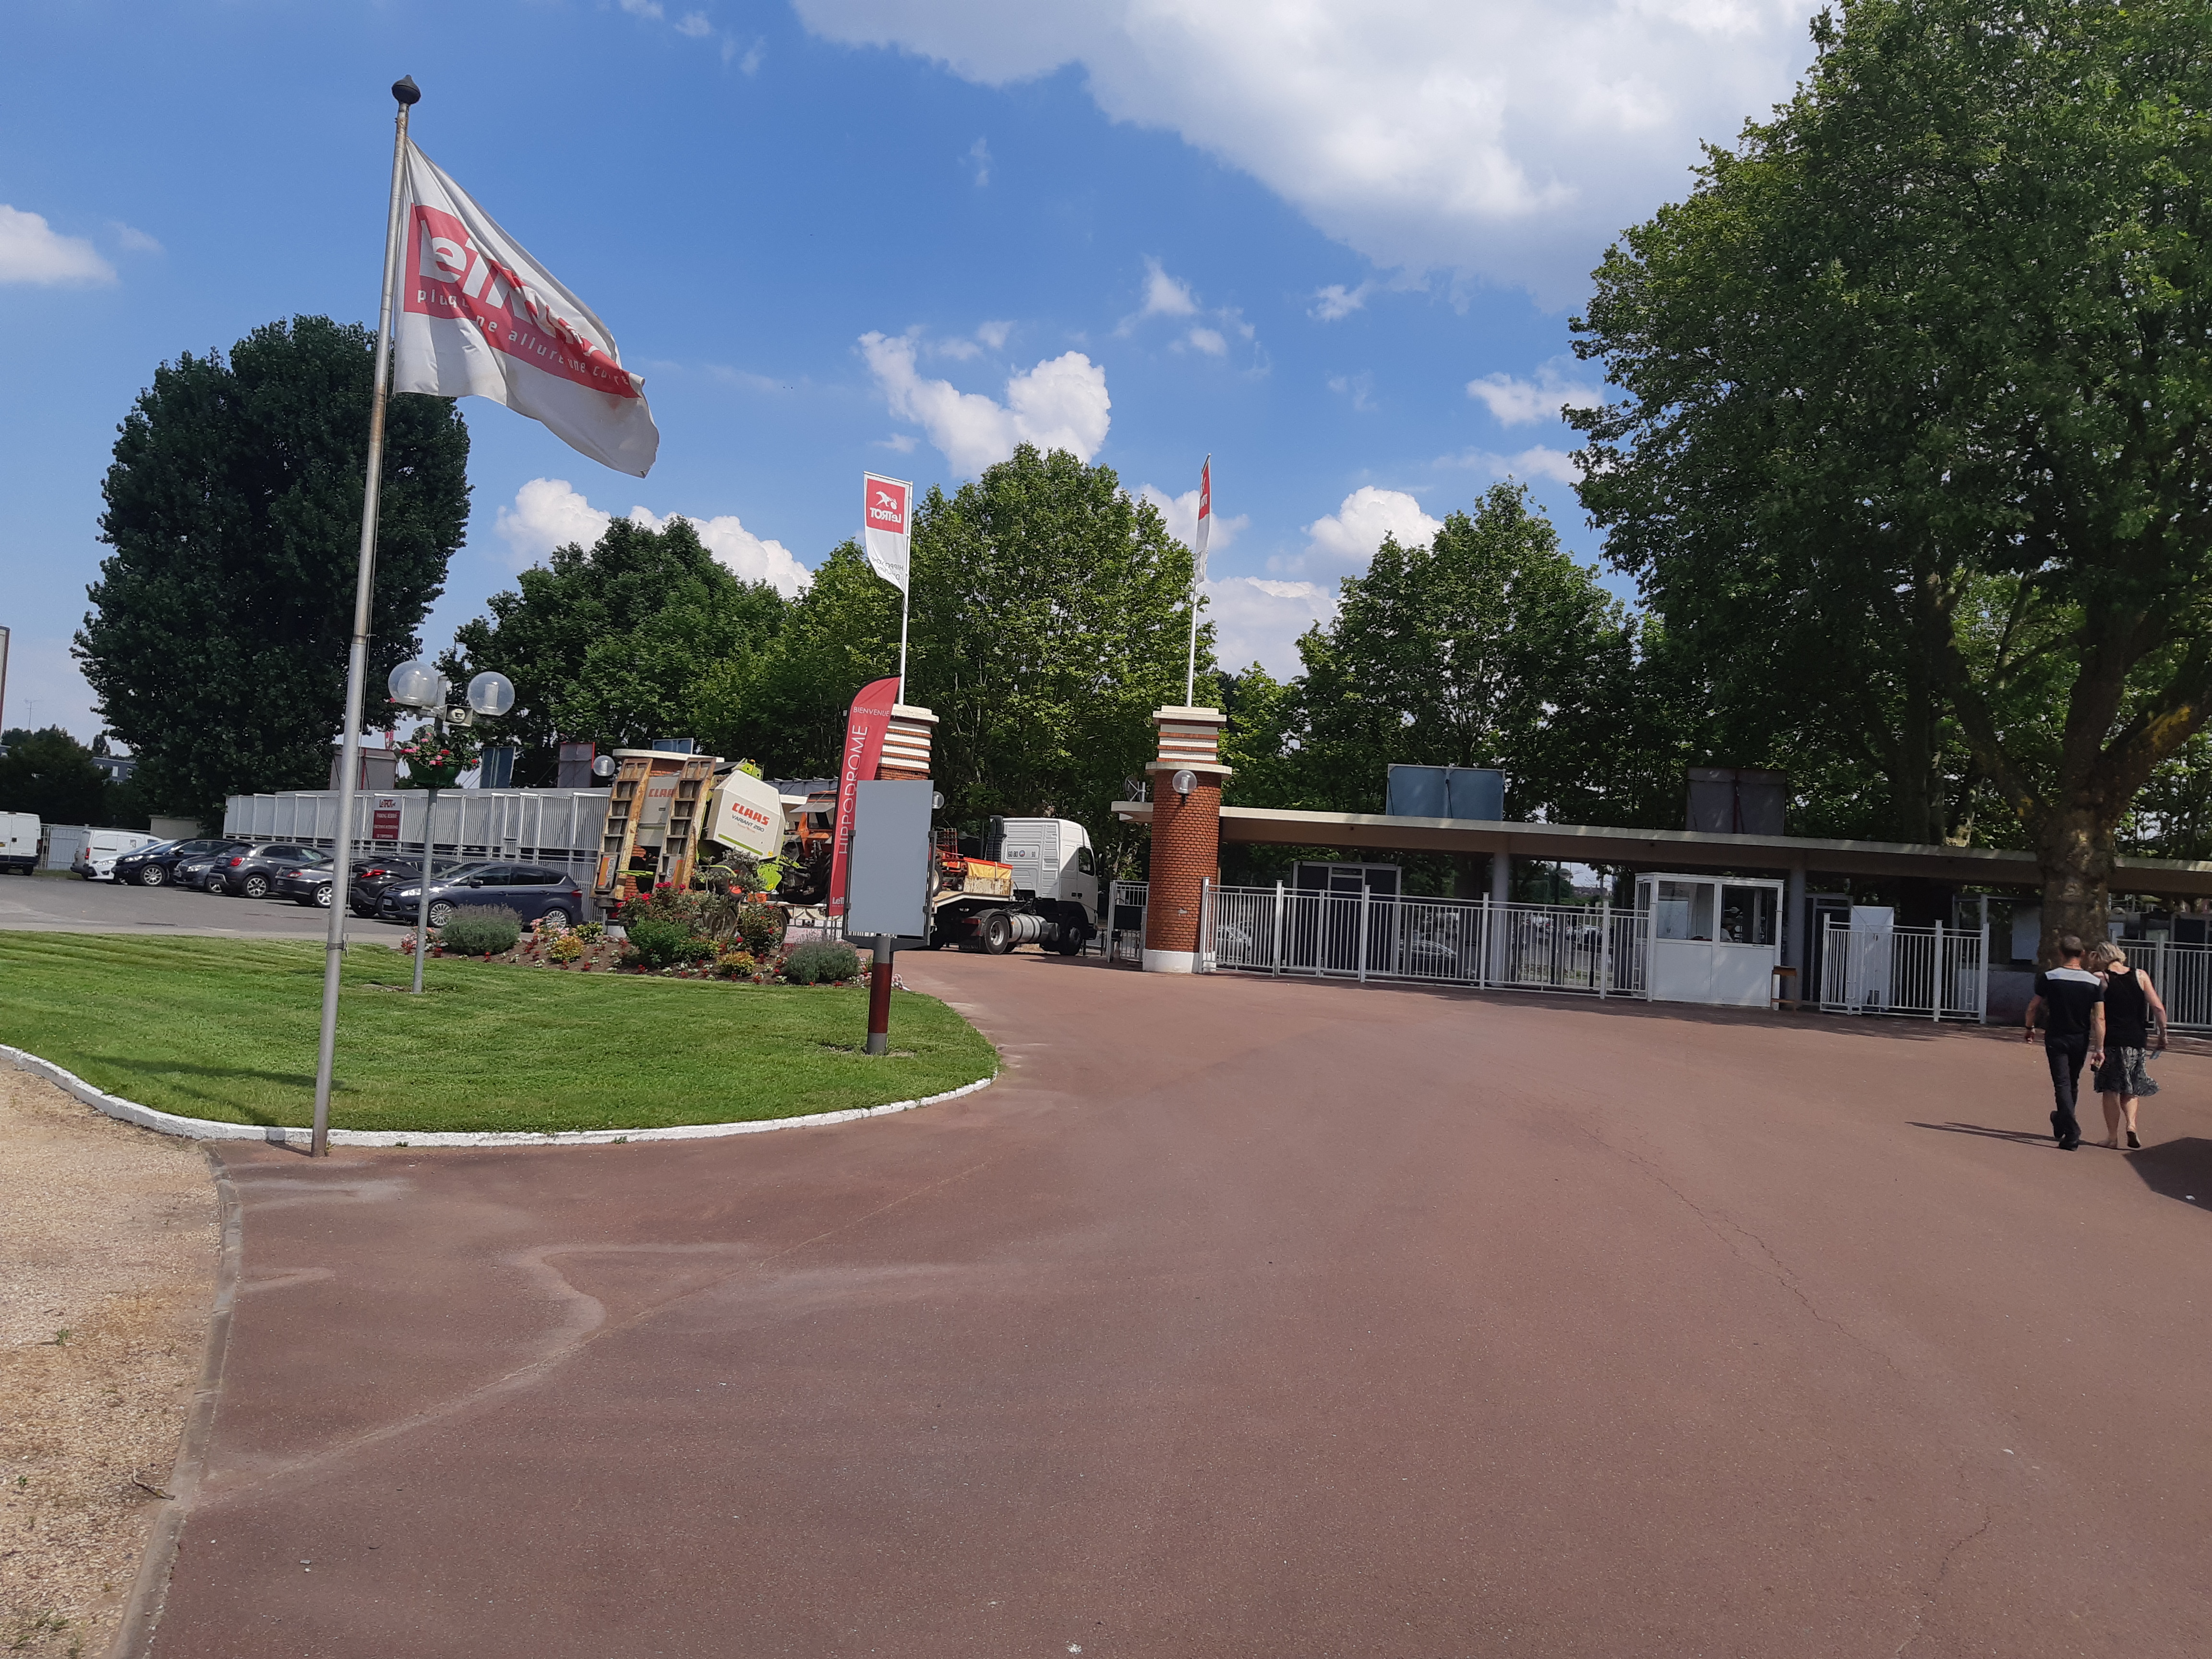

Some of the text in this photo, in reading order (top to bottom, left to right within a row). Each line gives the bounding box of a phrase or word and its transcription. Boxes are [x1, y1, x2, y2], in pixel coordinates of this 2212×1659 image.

[853, 706, 890, 717] BIENVENUE
[648, 788, 674, 797] CLAA
[839, 724, 868, 854] HIPPODROME
[732, 802, 770, 826] CLAAS
[732, 814, 754, 827] VARIANT
[753, 824, 765, 832] 280
